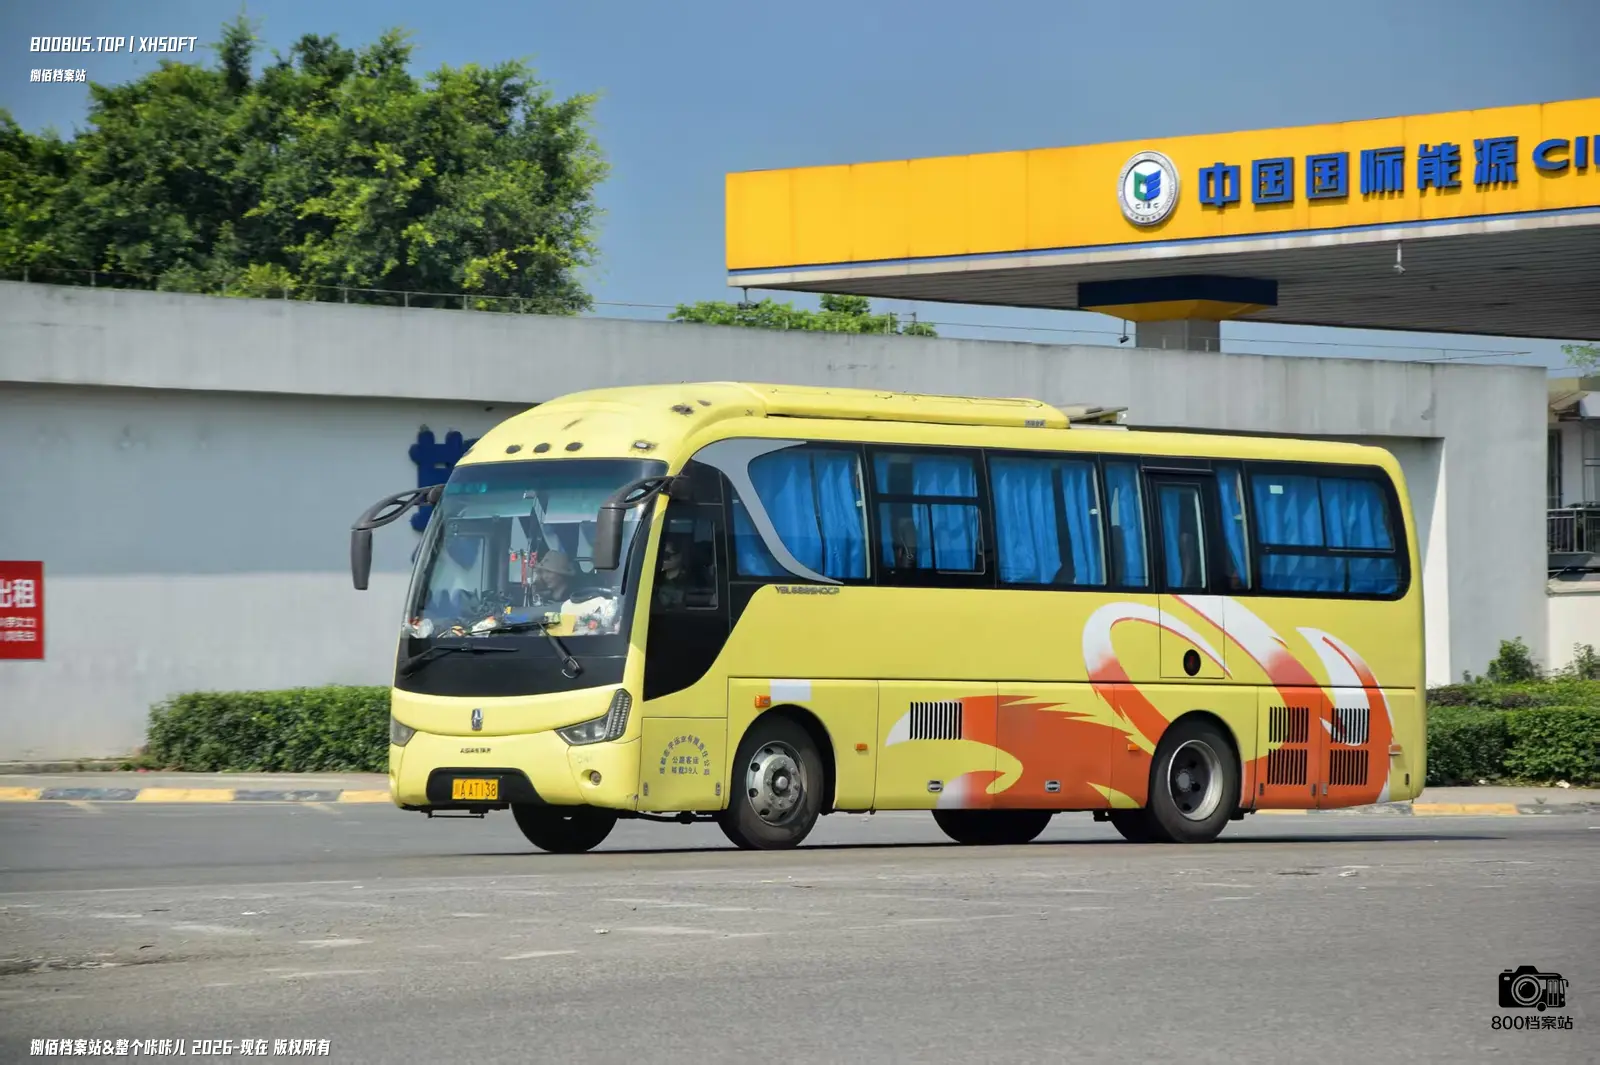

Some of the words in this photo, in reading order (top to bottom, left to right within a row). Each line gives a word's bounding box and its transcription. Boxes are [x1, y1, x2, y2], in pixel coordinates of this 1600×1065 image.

[1198, 135, 1519, 208] 中国国际能源
